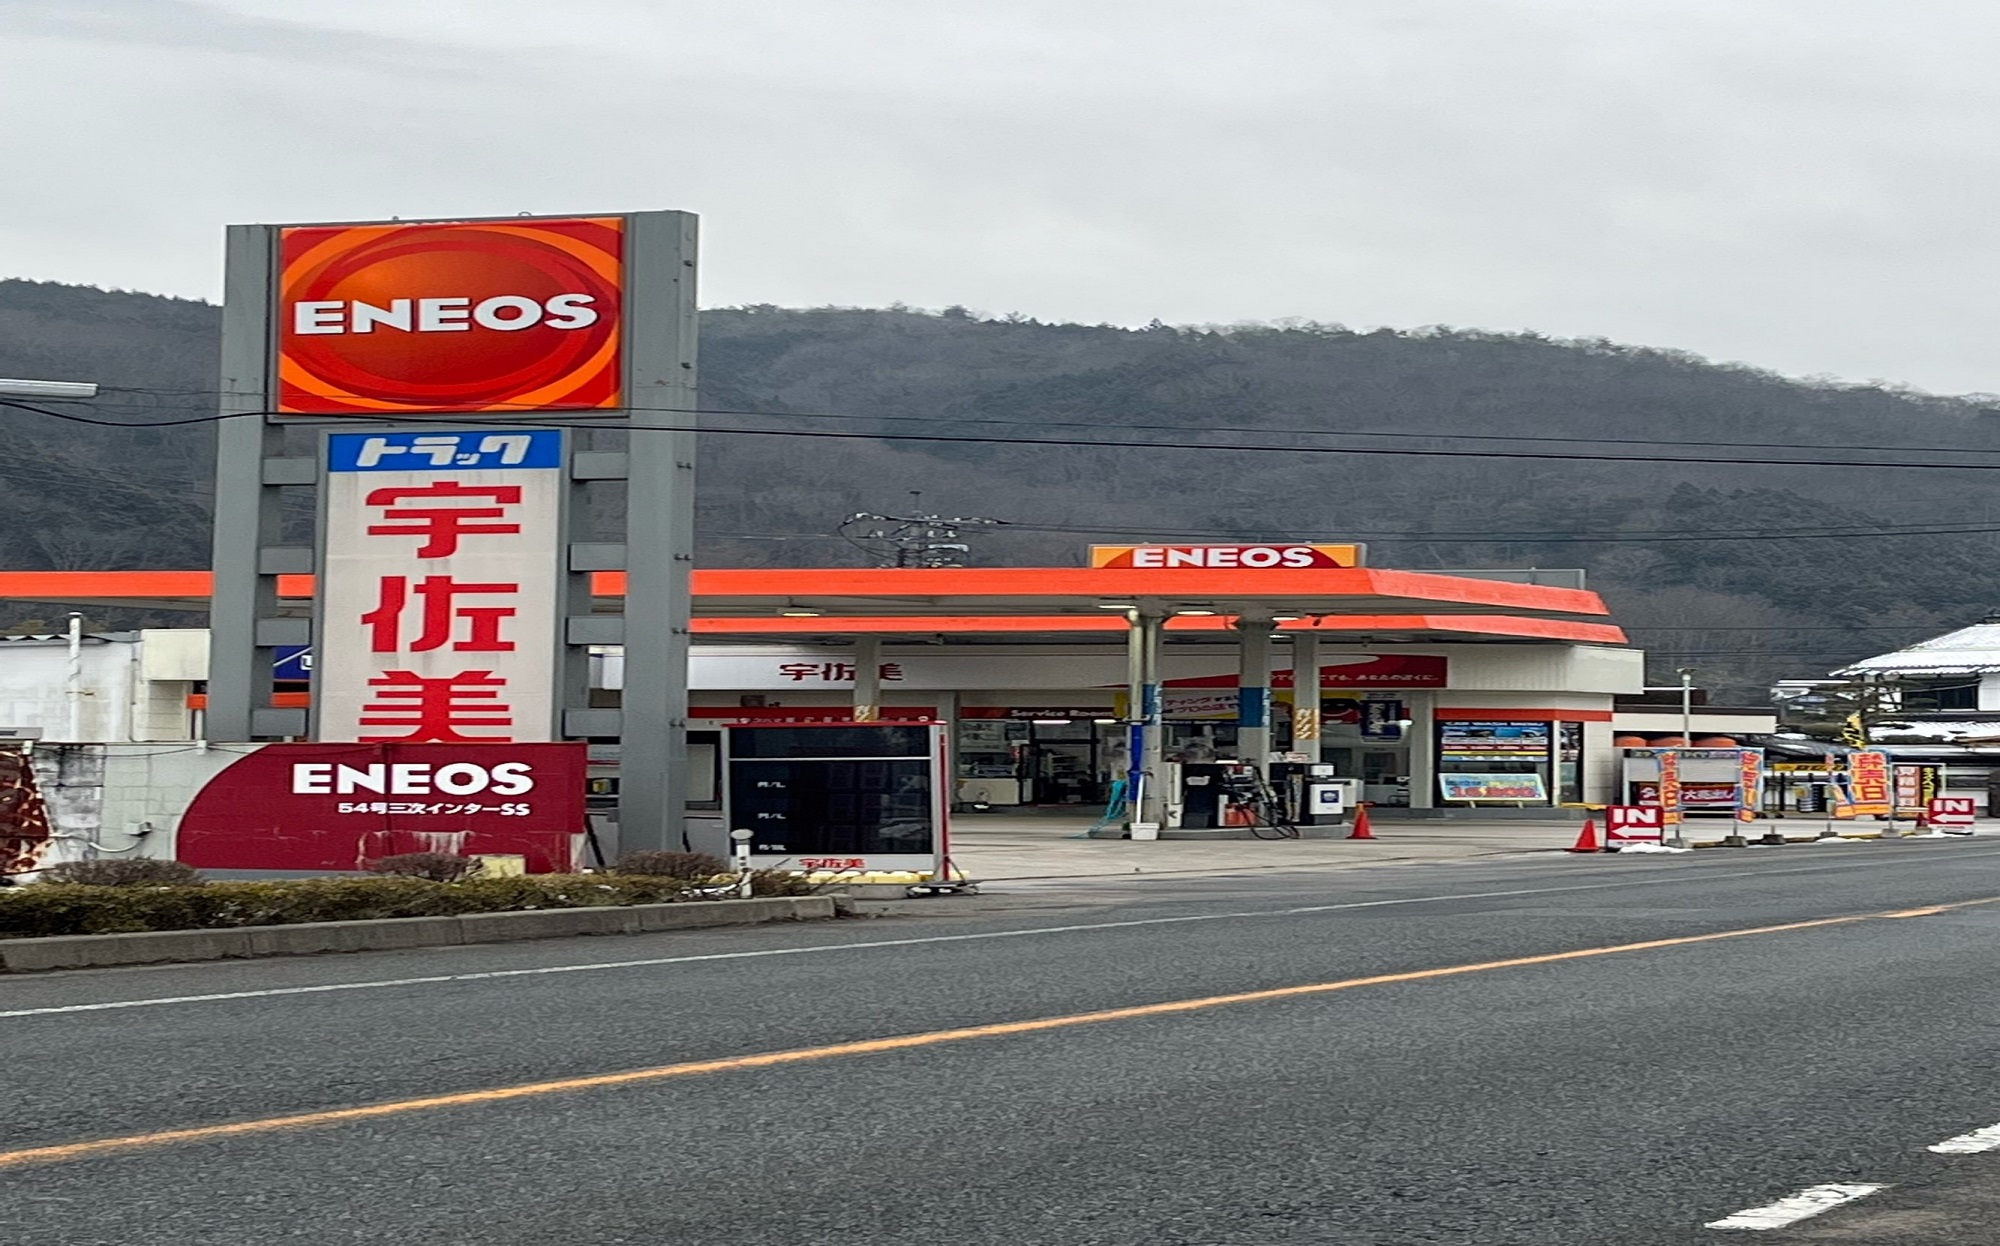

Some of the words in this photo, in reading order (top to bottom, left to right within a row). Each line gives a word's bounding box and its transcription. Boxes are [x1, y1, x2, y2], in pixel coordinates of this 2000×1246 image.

[293, 293, 598, 335] ENEOS
[356, 435, 532, 467] トラック
[1132, 546, 1315, 569] ENEOS
[359, 481, 523, 742] 宇佐美
[1010, 709, 1060, 719] Service
[292, 762, 534, 796] ENEOS
[338, 802, 530, 816] 54号三次インターSS
[1612, 808, 1657, 824] IN
[1932, 800, 1970, 812] IN
